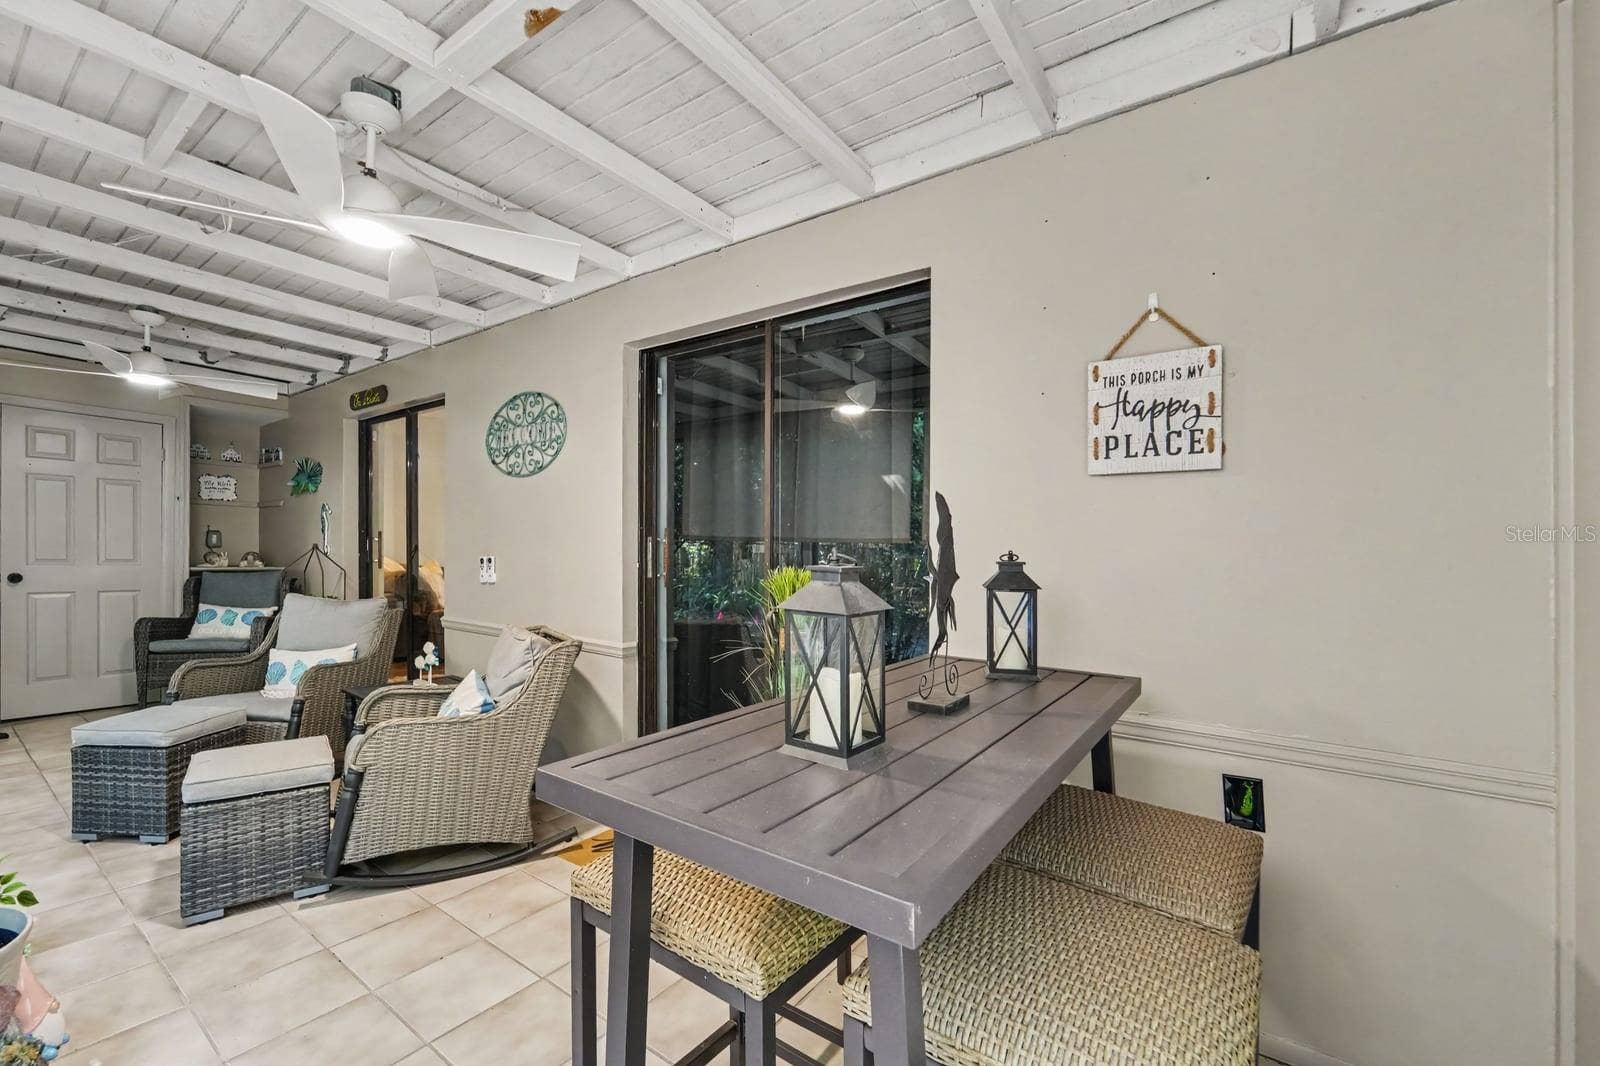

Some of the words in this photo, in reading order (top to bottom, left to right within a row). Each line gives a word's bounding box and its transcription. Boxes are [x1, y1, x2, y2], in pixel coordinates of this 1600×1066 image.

[1103, 375, 1126, 389] THIS
[1130, 370, 1166, 386] PORCH
[1171, 367, 1182, 380] IS
[1187, 364, 1205, 379] MY
[1098, 387, 1222, 432] Happy
[1104, 429, 1205, 460] PLACE
